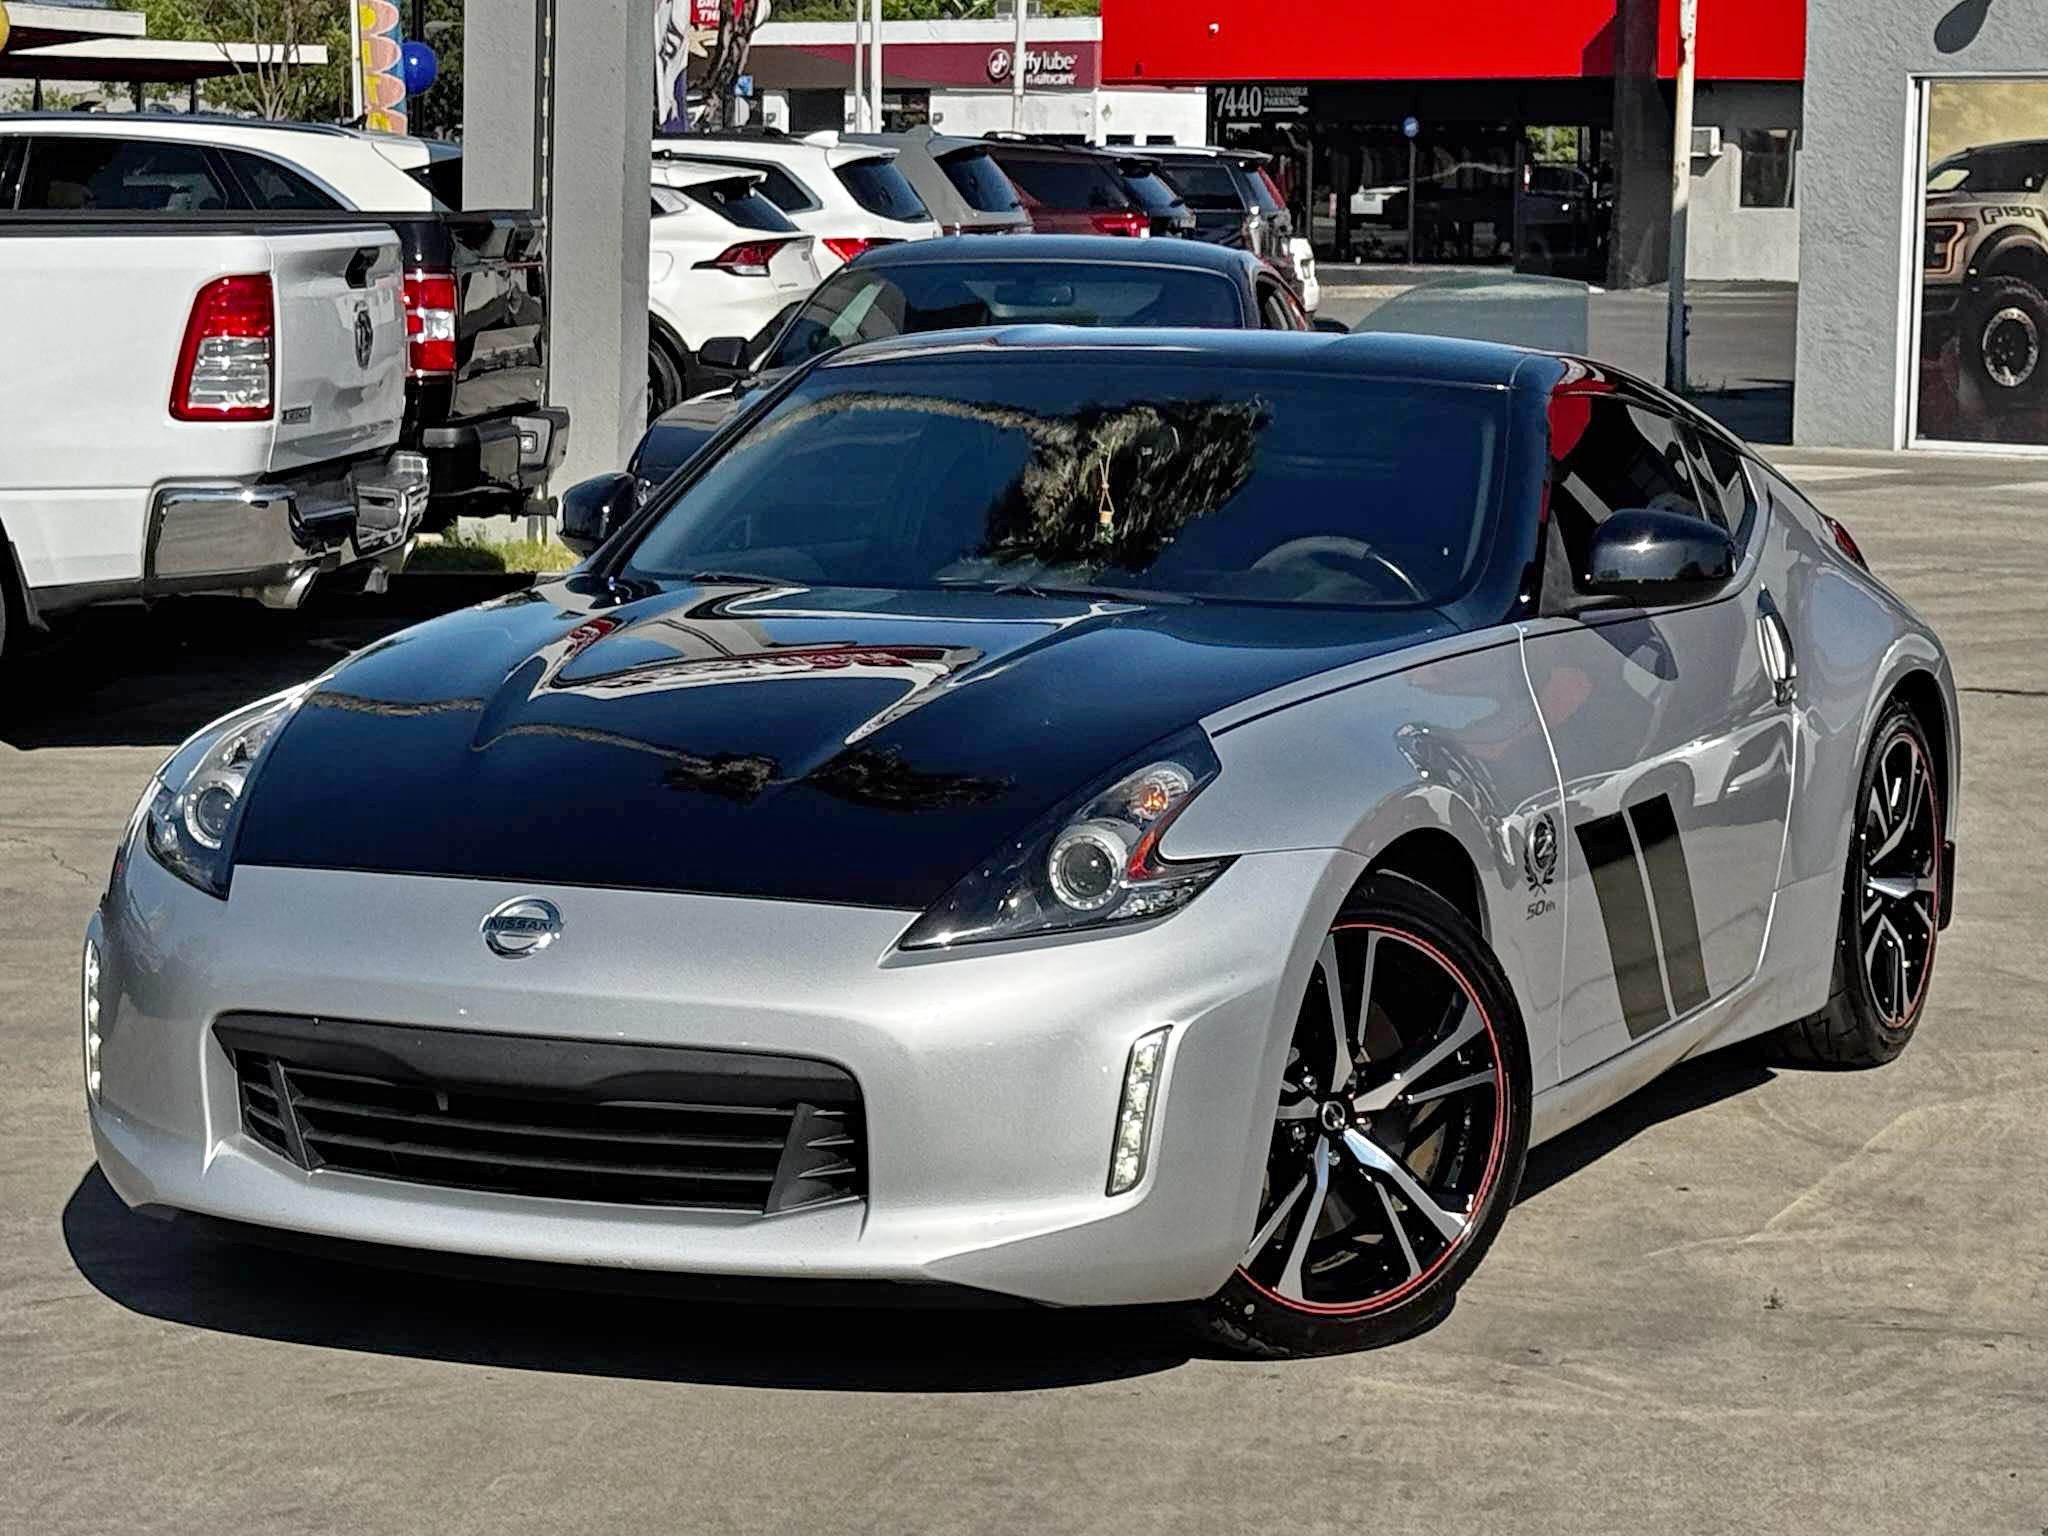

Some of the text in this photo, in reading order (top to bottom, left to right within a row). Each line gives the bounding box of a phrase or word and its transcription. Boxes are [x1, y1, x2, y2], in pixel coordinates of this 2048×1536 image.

[1042, 51, 1075, 70] lube
[1214, 86, 1262, 117] 7440
[1263, 96, 1300, 106] PARKING
[1526, 900, 1556, 920] 50th
[486, 917, 554, 932] NISSAN
